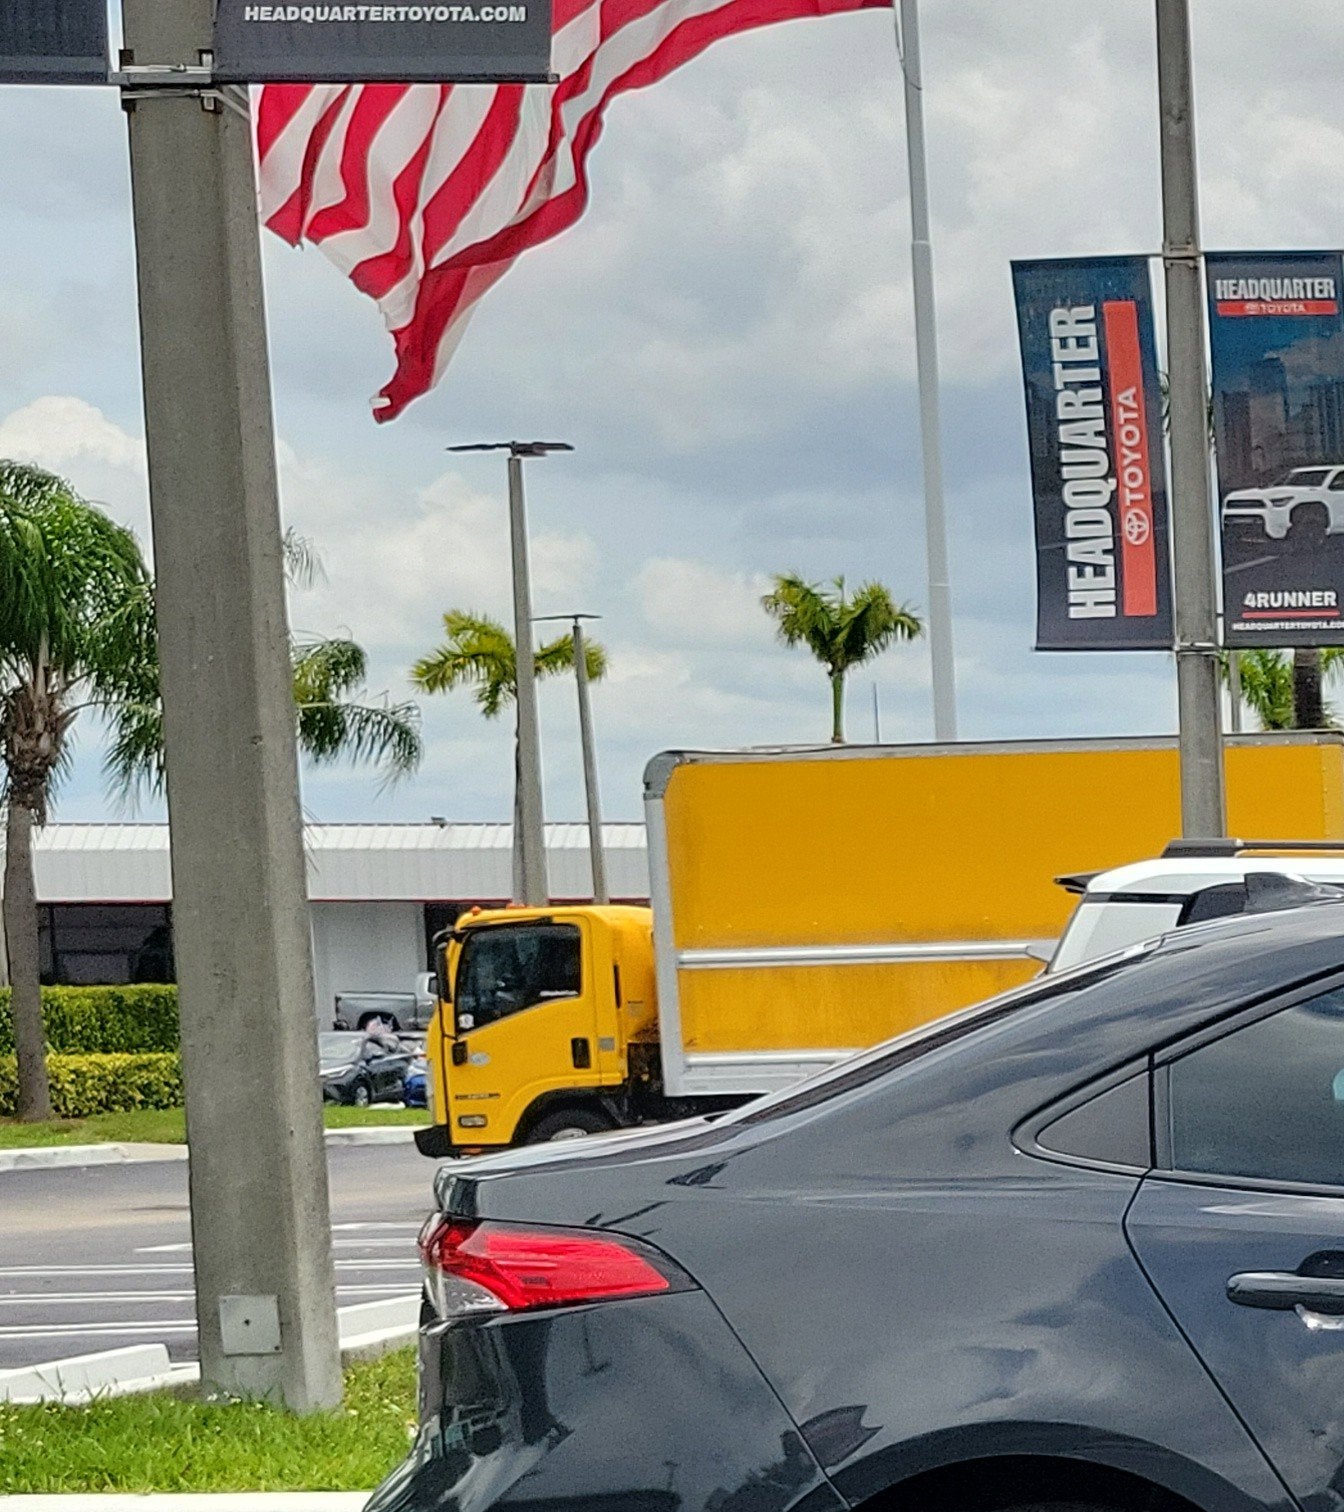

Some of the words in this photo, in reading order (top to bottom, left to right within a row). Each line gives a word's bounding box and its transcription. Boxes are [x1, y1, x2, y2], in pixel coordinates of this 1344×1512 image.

[244, 5, 527, 22] HEADQUARTERTOYOTA.COM
[1216, 278, 1335, 301] HEADQUARTER
[1116, 386, 1144, 506] TOYOTA
[1050, 304, 1117, 619] HEADQUARTER
[1244, 591, 1337, 608] 4RUNNER
